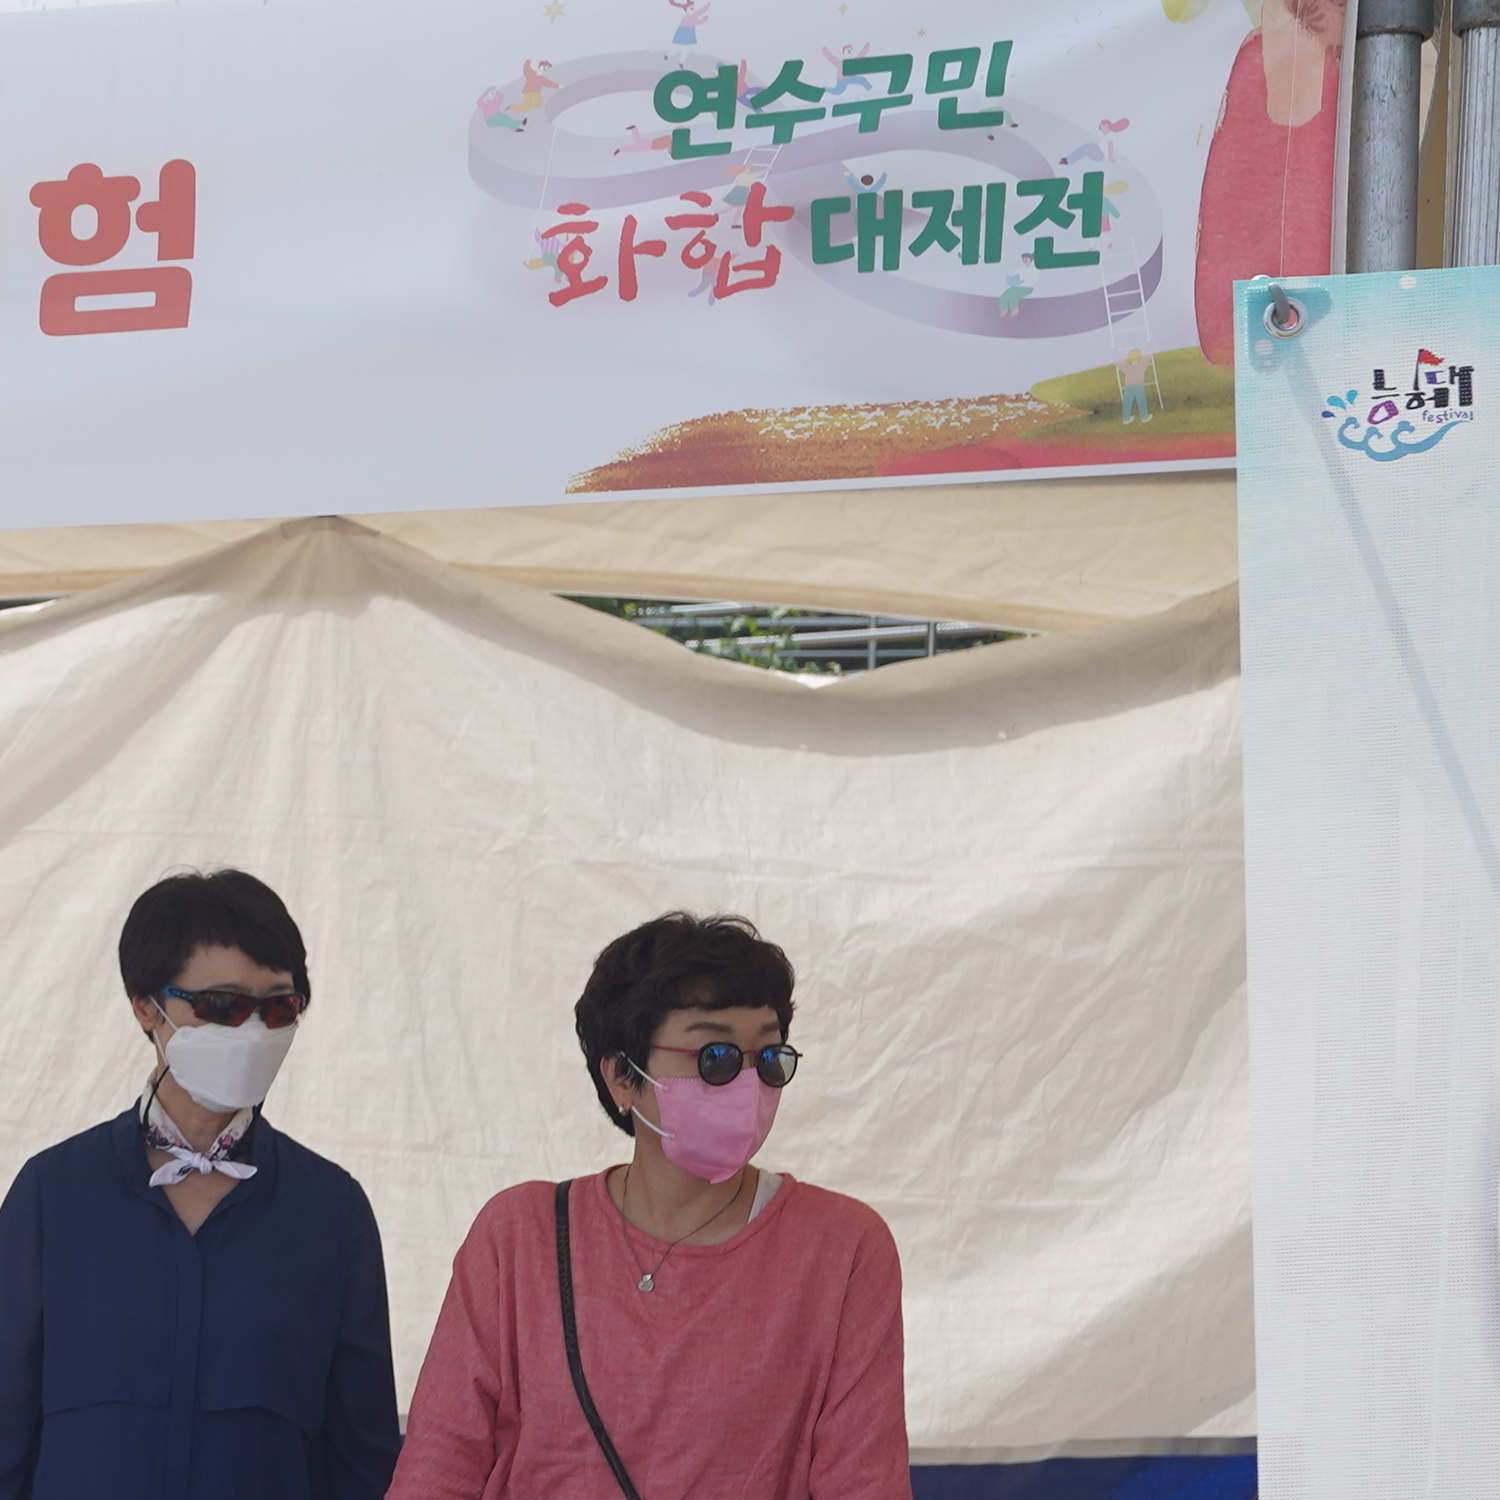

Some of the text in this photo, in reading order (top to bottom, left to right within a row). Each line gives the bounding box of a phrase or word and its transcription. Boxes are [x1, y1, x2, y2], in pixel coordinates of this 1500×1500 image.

[653, 40, 1013, 160] 연수구민
[544, 171, 1104, 302] 화합 대제전
[1421, 409, 1474, 424] festival
